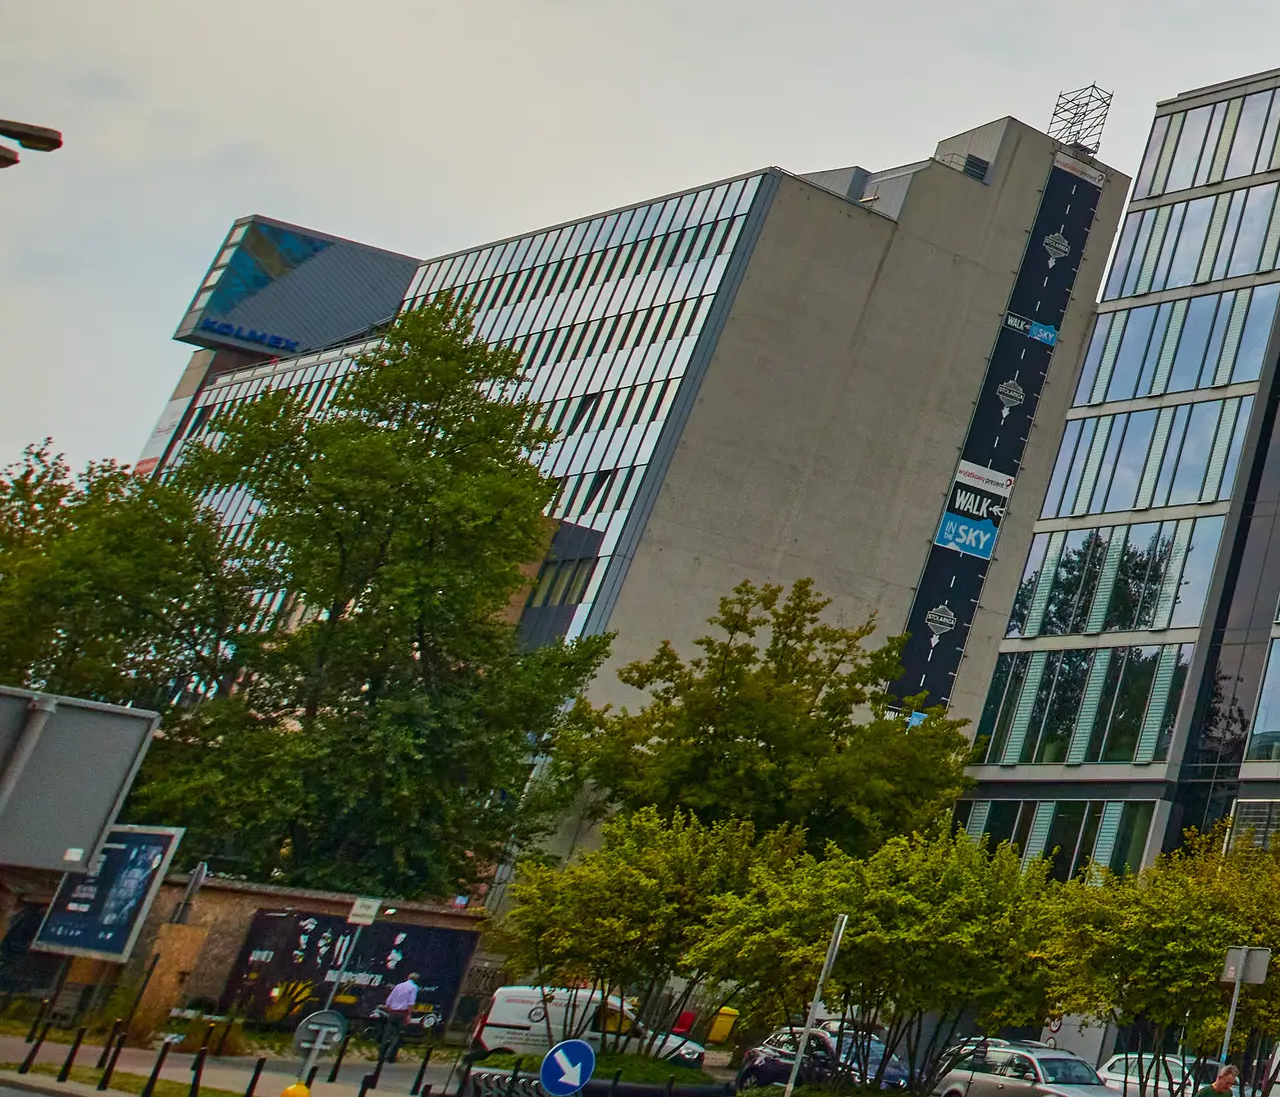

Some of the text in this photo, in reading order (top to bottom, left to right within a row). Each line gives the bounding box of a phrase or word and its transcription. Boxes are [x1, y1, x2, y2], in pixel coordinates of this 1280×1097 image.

[201, 318, 300, 352] KOLMEX
[1007, 315, 1026, 330] WALK
[1037, 328, 1055, 341] SKY
[955, 489, 992, 518] WALK
[945, 520, 991, 550] IN SKY
